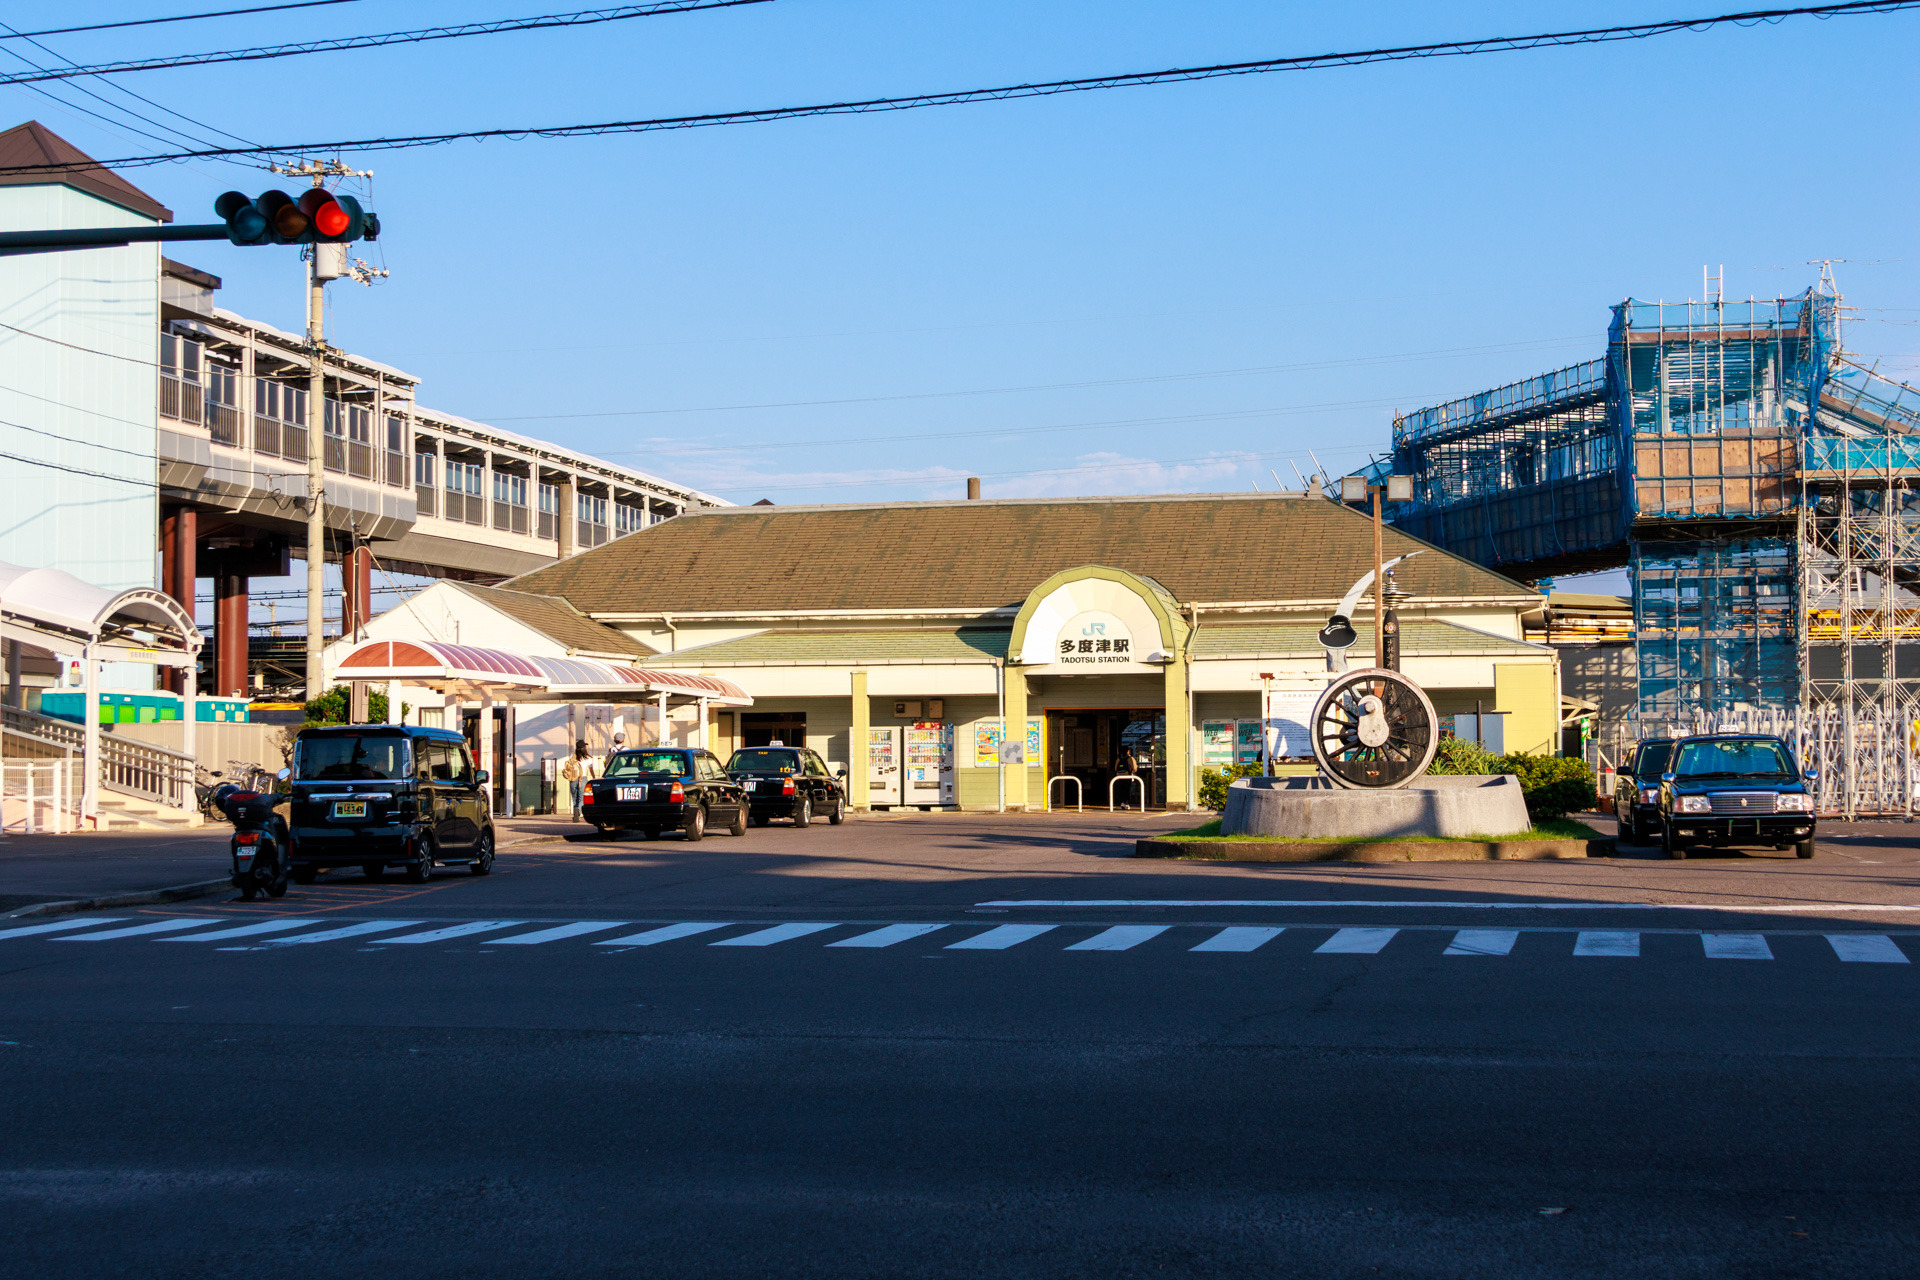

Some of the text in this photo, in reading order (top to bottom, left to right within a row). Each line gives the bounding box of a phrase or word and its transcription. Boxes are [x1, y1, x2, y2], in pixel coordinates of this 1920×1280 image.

[1082, 622, 1106, 636] JR
[1060, 639, 1129, 653] 多度津駅
[1060, 656, 1096, 664] TADOTSU
[1204, 729, 1219, 737] WEB
